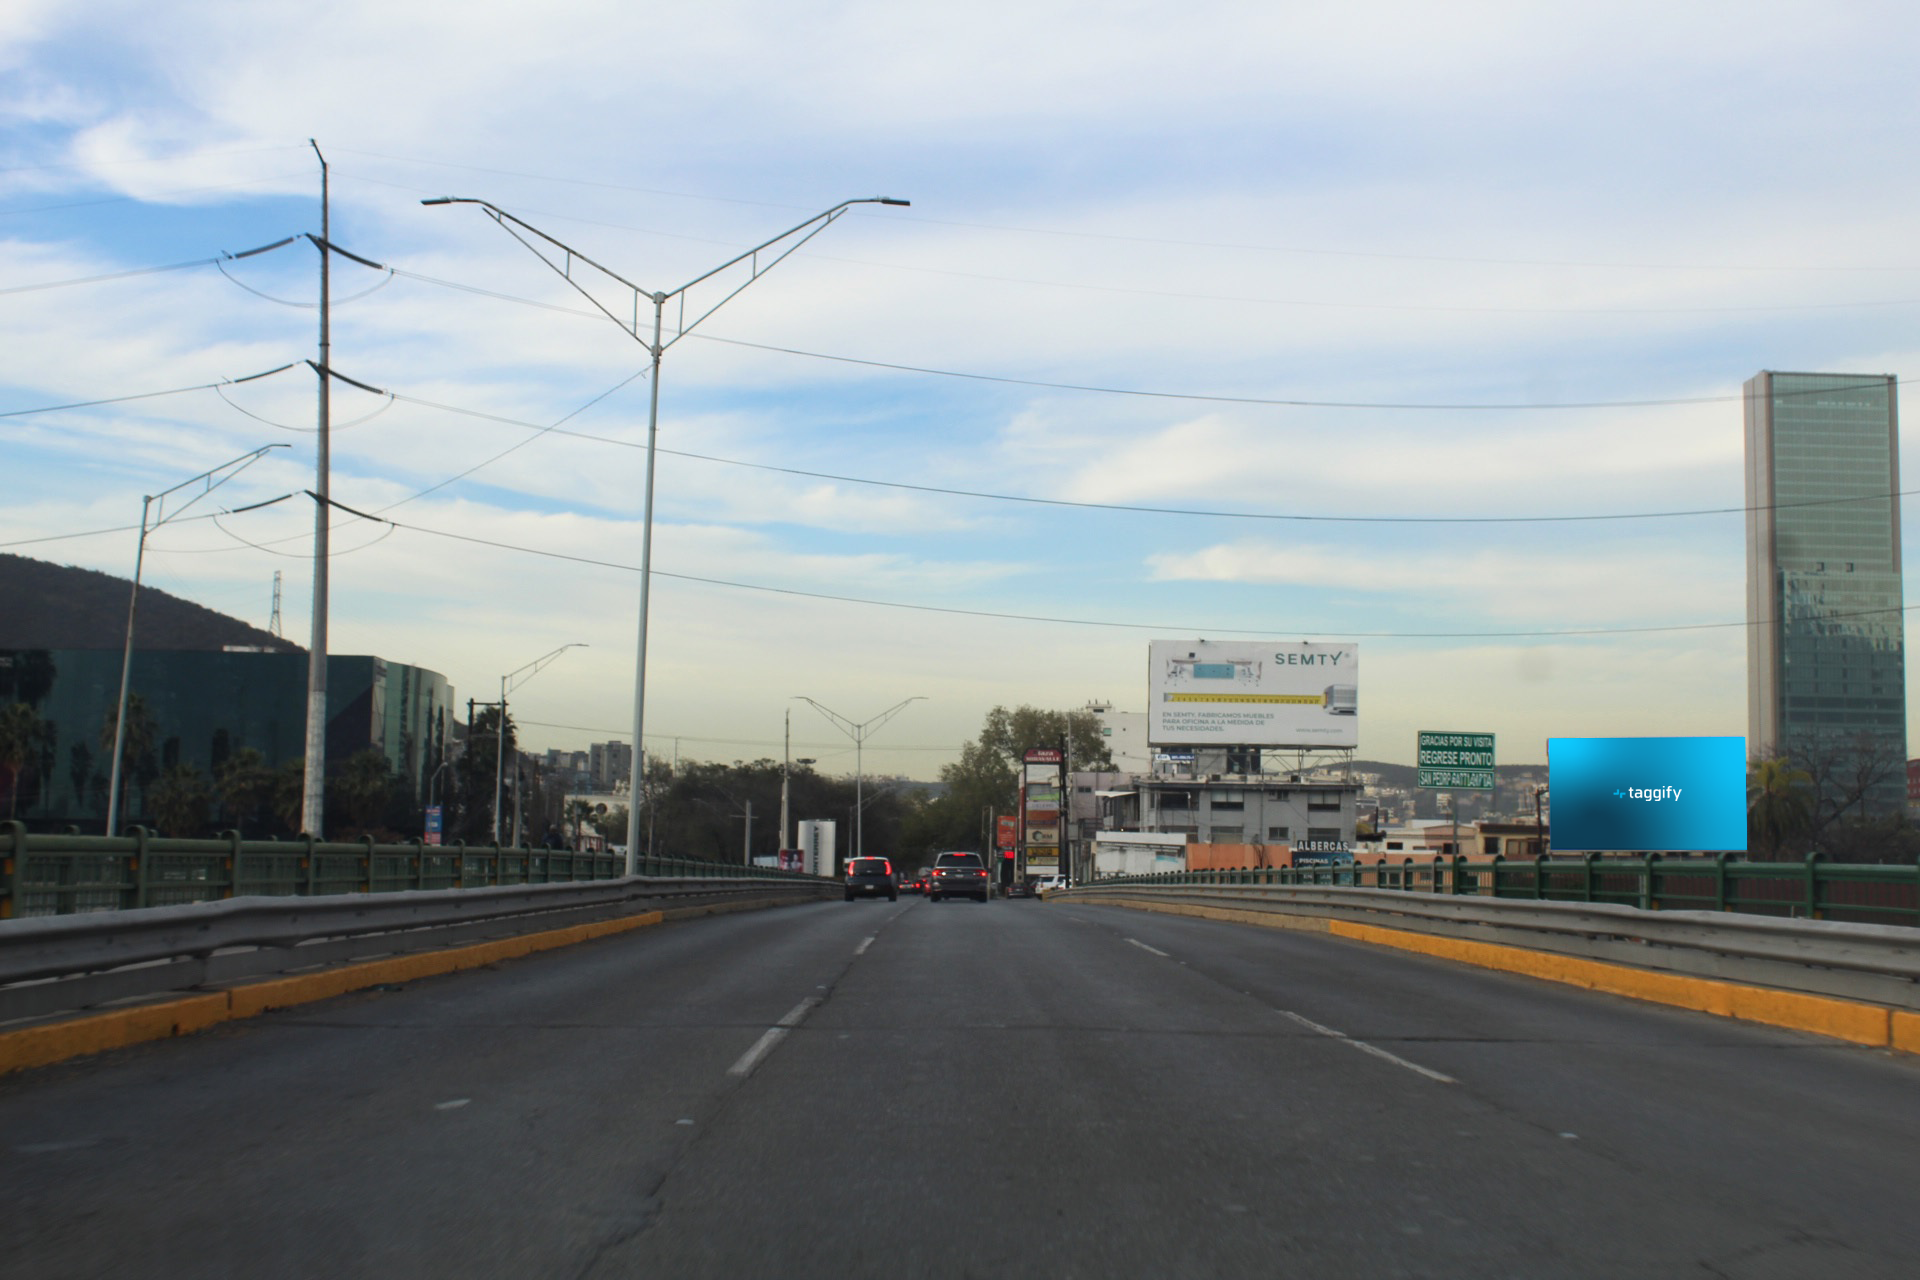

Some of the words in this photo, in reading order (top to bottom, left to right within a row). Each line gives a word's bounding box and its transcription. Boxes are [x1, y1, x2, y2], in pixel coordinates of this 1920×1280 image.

[1275, 651, 1342, 666] SEMTY
[1197, 711, 1242, 719] FABRICAMOS
[1243, 712, 1275, 720] MUEBLES
[1421, 735, 1448, 746] GRACIAS
[1449, 736, 1462, 747] POR
[1464, 736, 1472, 748] SU
[1474, 737, 1493, 748] VISITA
[1420, 750, 1458, 765] REGRESE
[1460, 751, 1493, 766] PRONTO
[1628, 785, 1683, 802] taggify
[1298, 840, 1349, 851] ALBERCAS
[1298, 857, 1329, 865] PISCINAS
